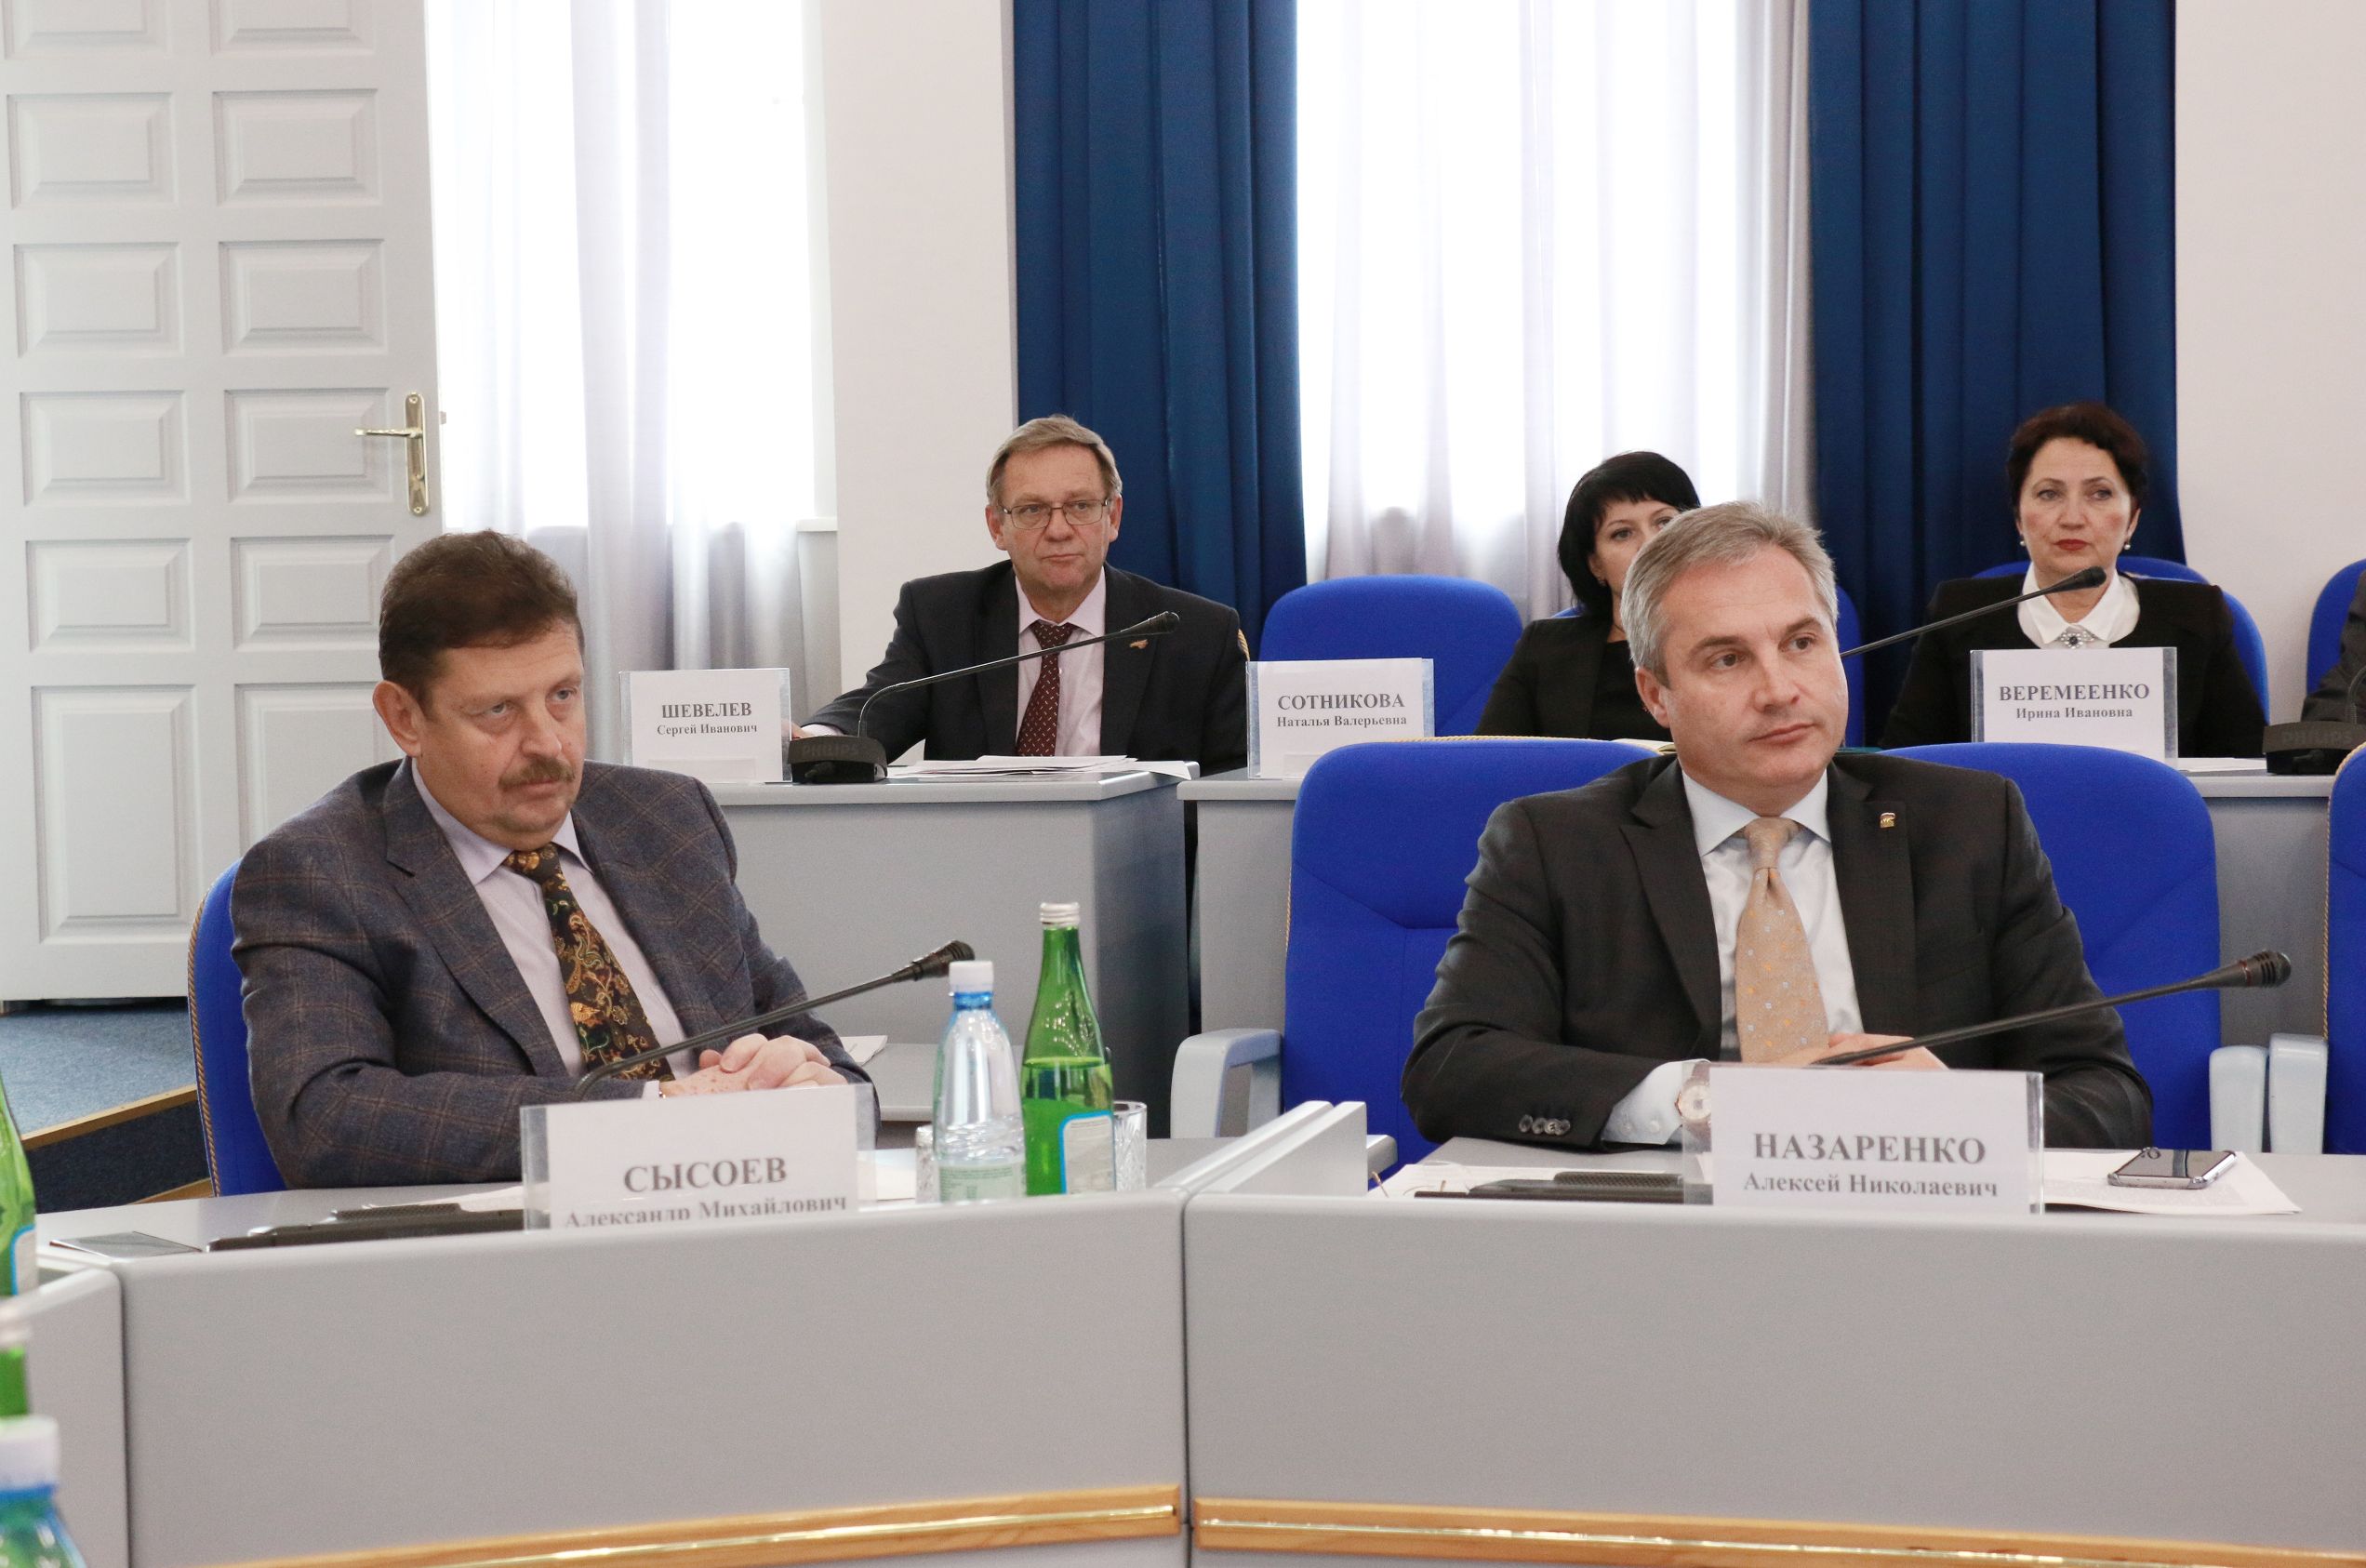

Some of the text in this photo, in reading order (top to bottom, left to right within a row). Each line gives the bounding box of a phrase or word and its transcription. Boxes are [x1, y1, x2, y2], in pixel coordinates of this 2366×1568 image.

[2000, 684, 2150, 701] ВЕРЕМЕЕНКО
[1278, 693, 1405, 710] СОТНИКОВА
[661, 702, 752, 718] ШЕВЕЛЕВ
[2016, 707, 2133, 722] Ирина Ивановна
[1277, 715, 1408, 728] Наталья Валерьевна
[657, 724, 758, 737] Сергей Иванович
[2281, 730, 2353, 745] PHILIPS
[802, 744, 859, 758] PHILIPS
[1753, 1132, 1987, 1164] НАЗАРЕНКО
[623, 1157, 787, 1193] СЫСОЕВ
[1744, 1172, 1999, 1197] Алексей Николаевич
[699, 1195, 847, 1219] Михайлович
